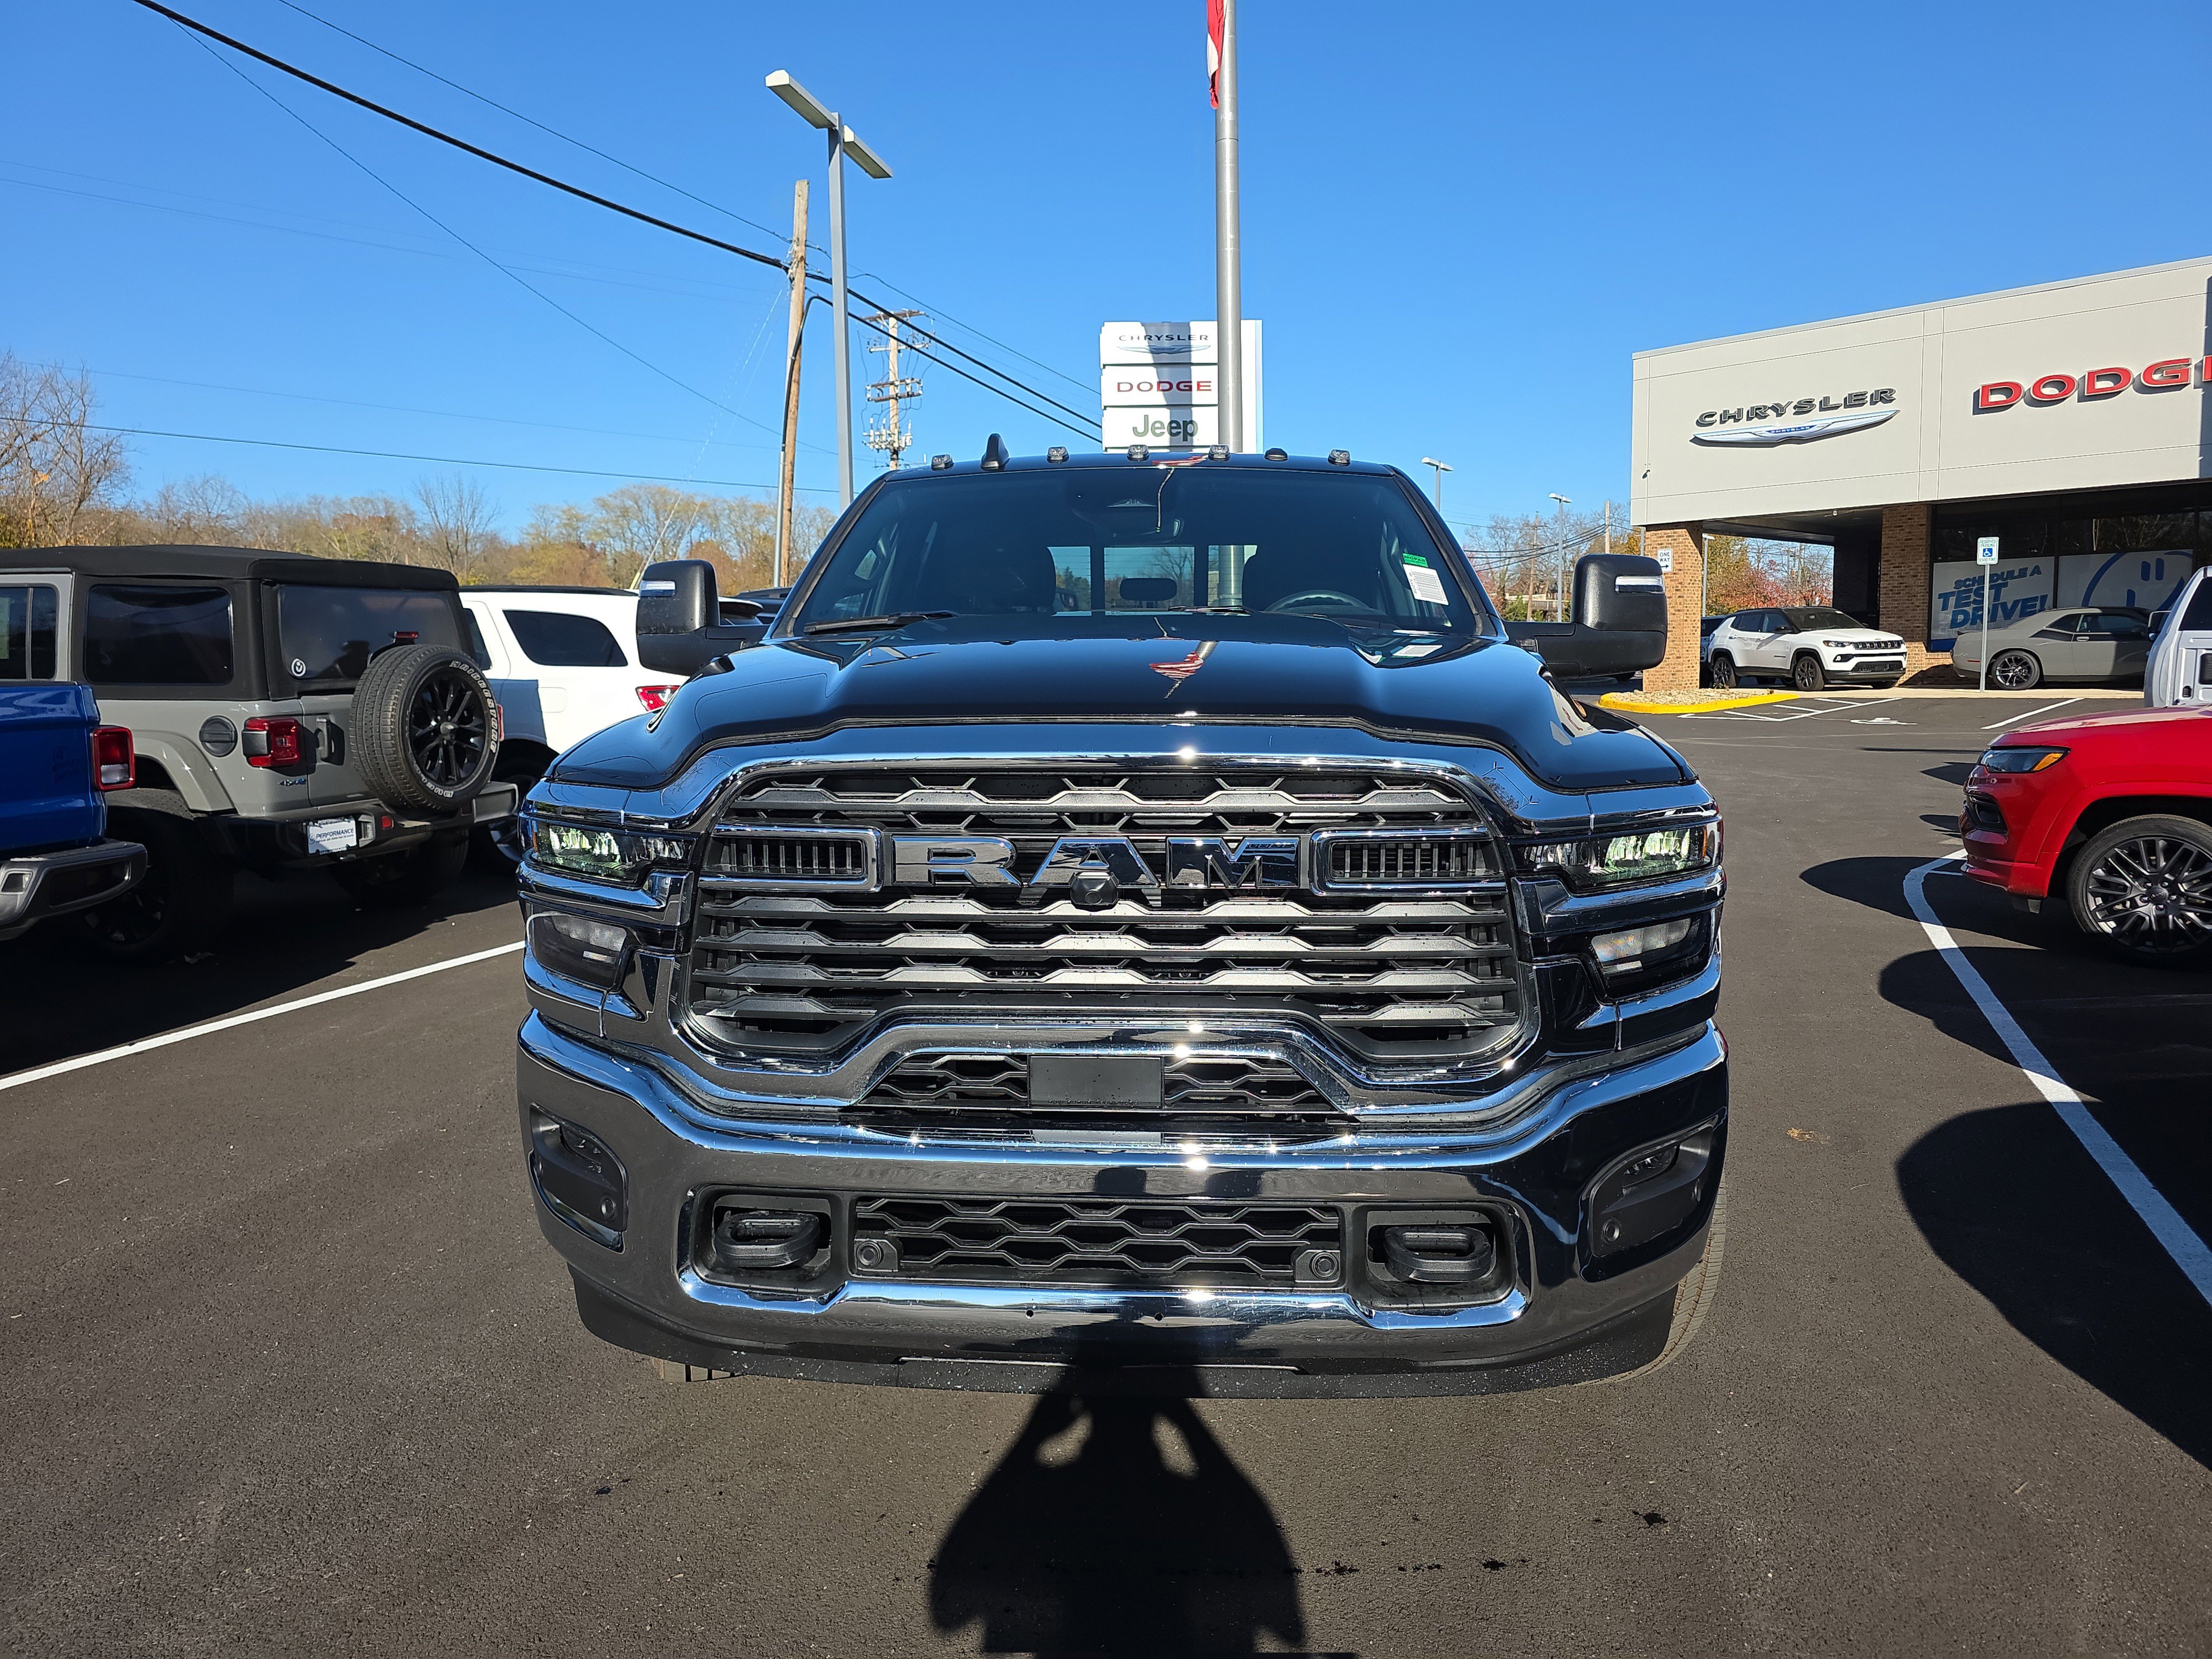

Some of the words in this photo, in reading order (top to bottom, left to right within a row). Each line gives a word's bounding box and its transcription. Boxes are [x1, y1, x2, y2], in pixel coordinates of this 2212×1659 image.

[1117, 380, 1212, 392] DODGE
[1979, 355, 2212, 408] DODG
[1697, 387, 1896, 426] CHRYSLER
[1133, 414, 1198, 442] Jeep
[2029, 564, 2042, 577] A
[1938, 581, 2009, 611] TEST
[1949, 594, 2048, 629] DRIVE!
[449, 660, 498, 753] BRIDGESTONE
[316, 828, 354, 839] PERFORMANCE
[891, 835, 1301, 888] RAM
